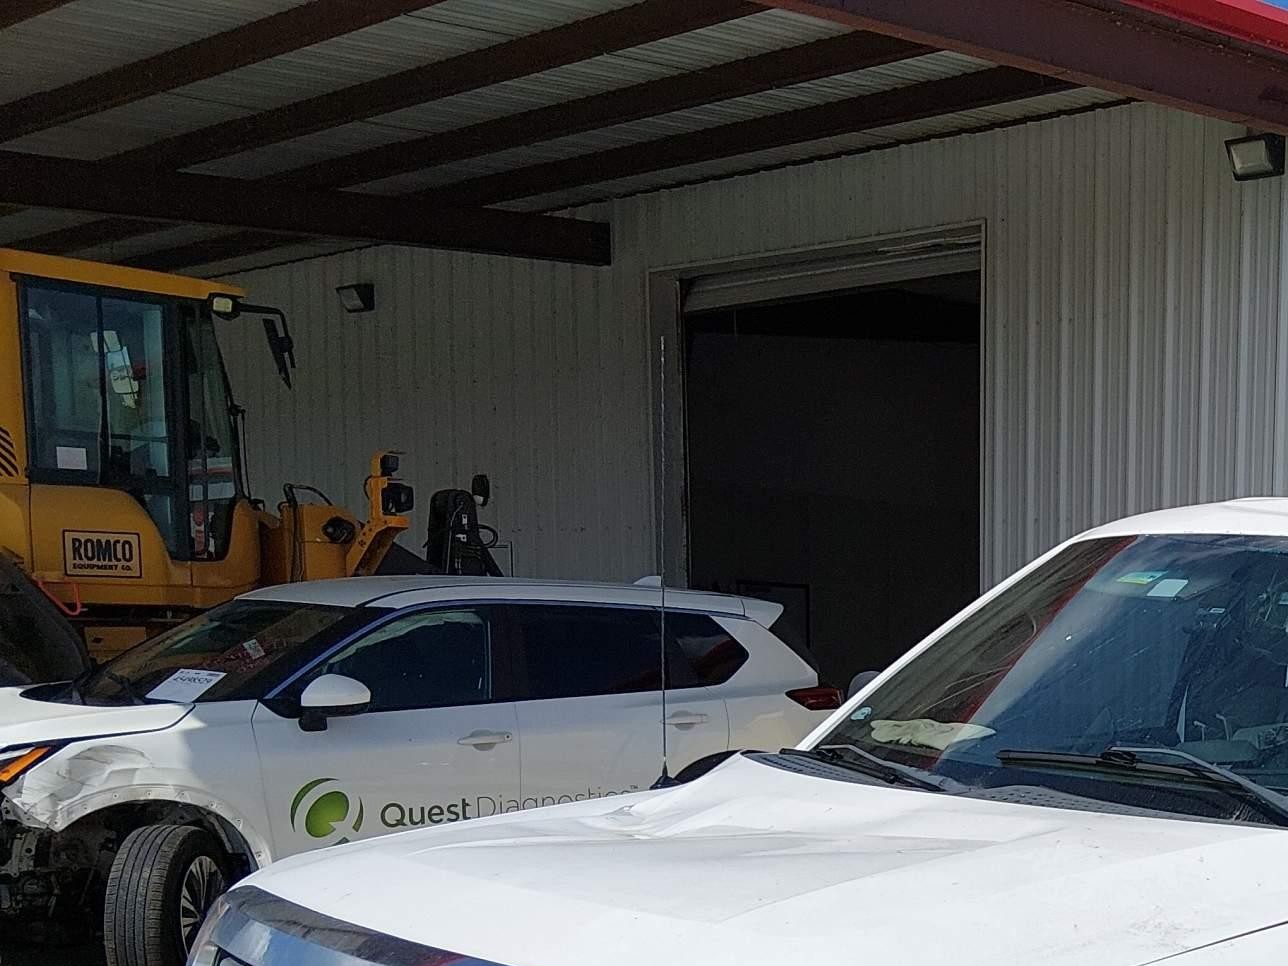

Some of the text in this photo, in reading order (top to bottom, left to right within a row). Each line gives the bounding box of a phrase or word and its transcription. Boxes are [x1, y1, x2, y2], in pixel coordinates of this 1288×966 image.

[72, 538, 133, 562] ROMCO
[72, 563, 118, 571] EQUIPMENT
[380, 798, 471, 828] Quest
